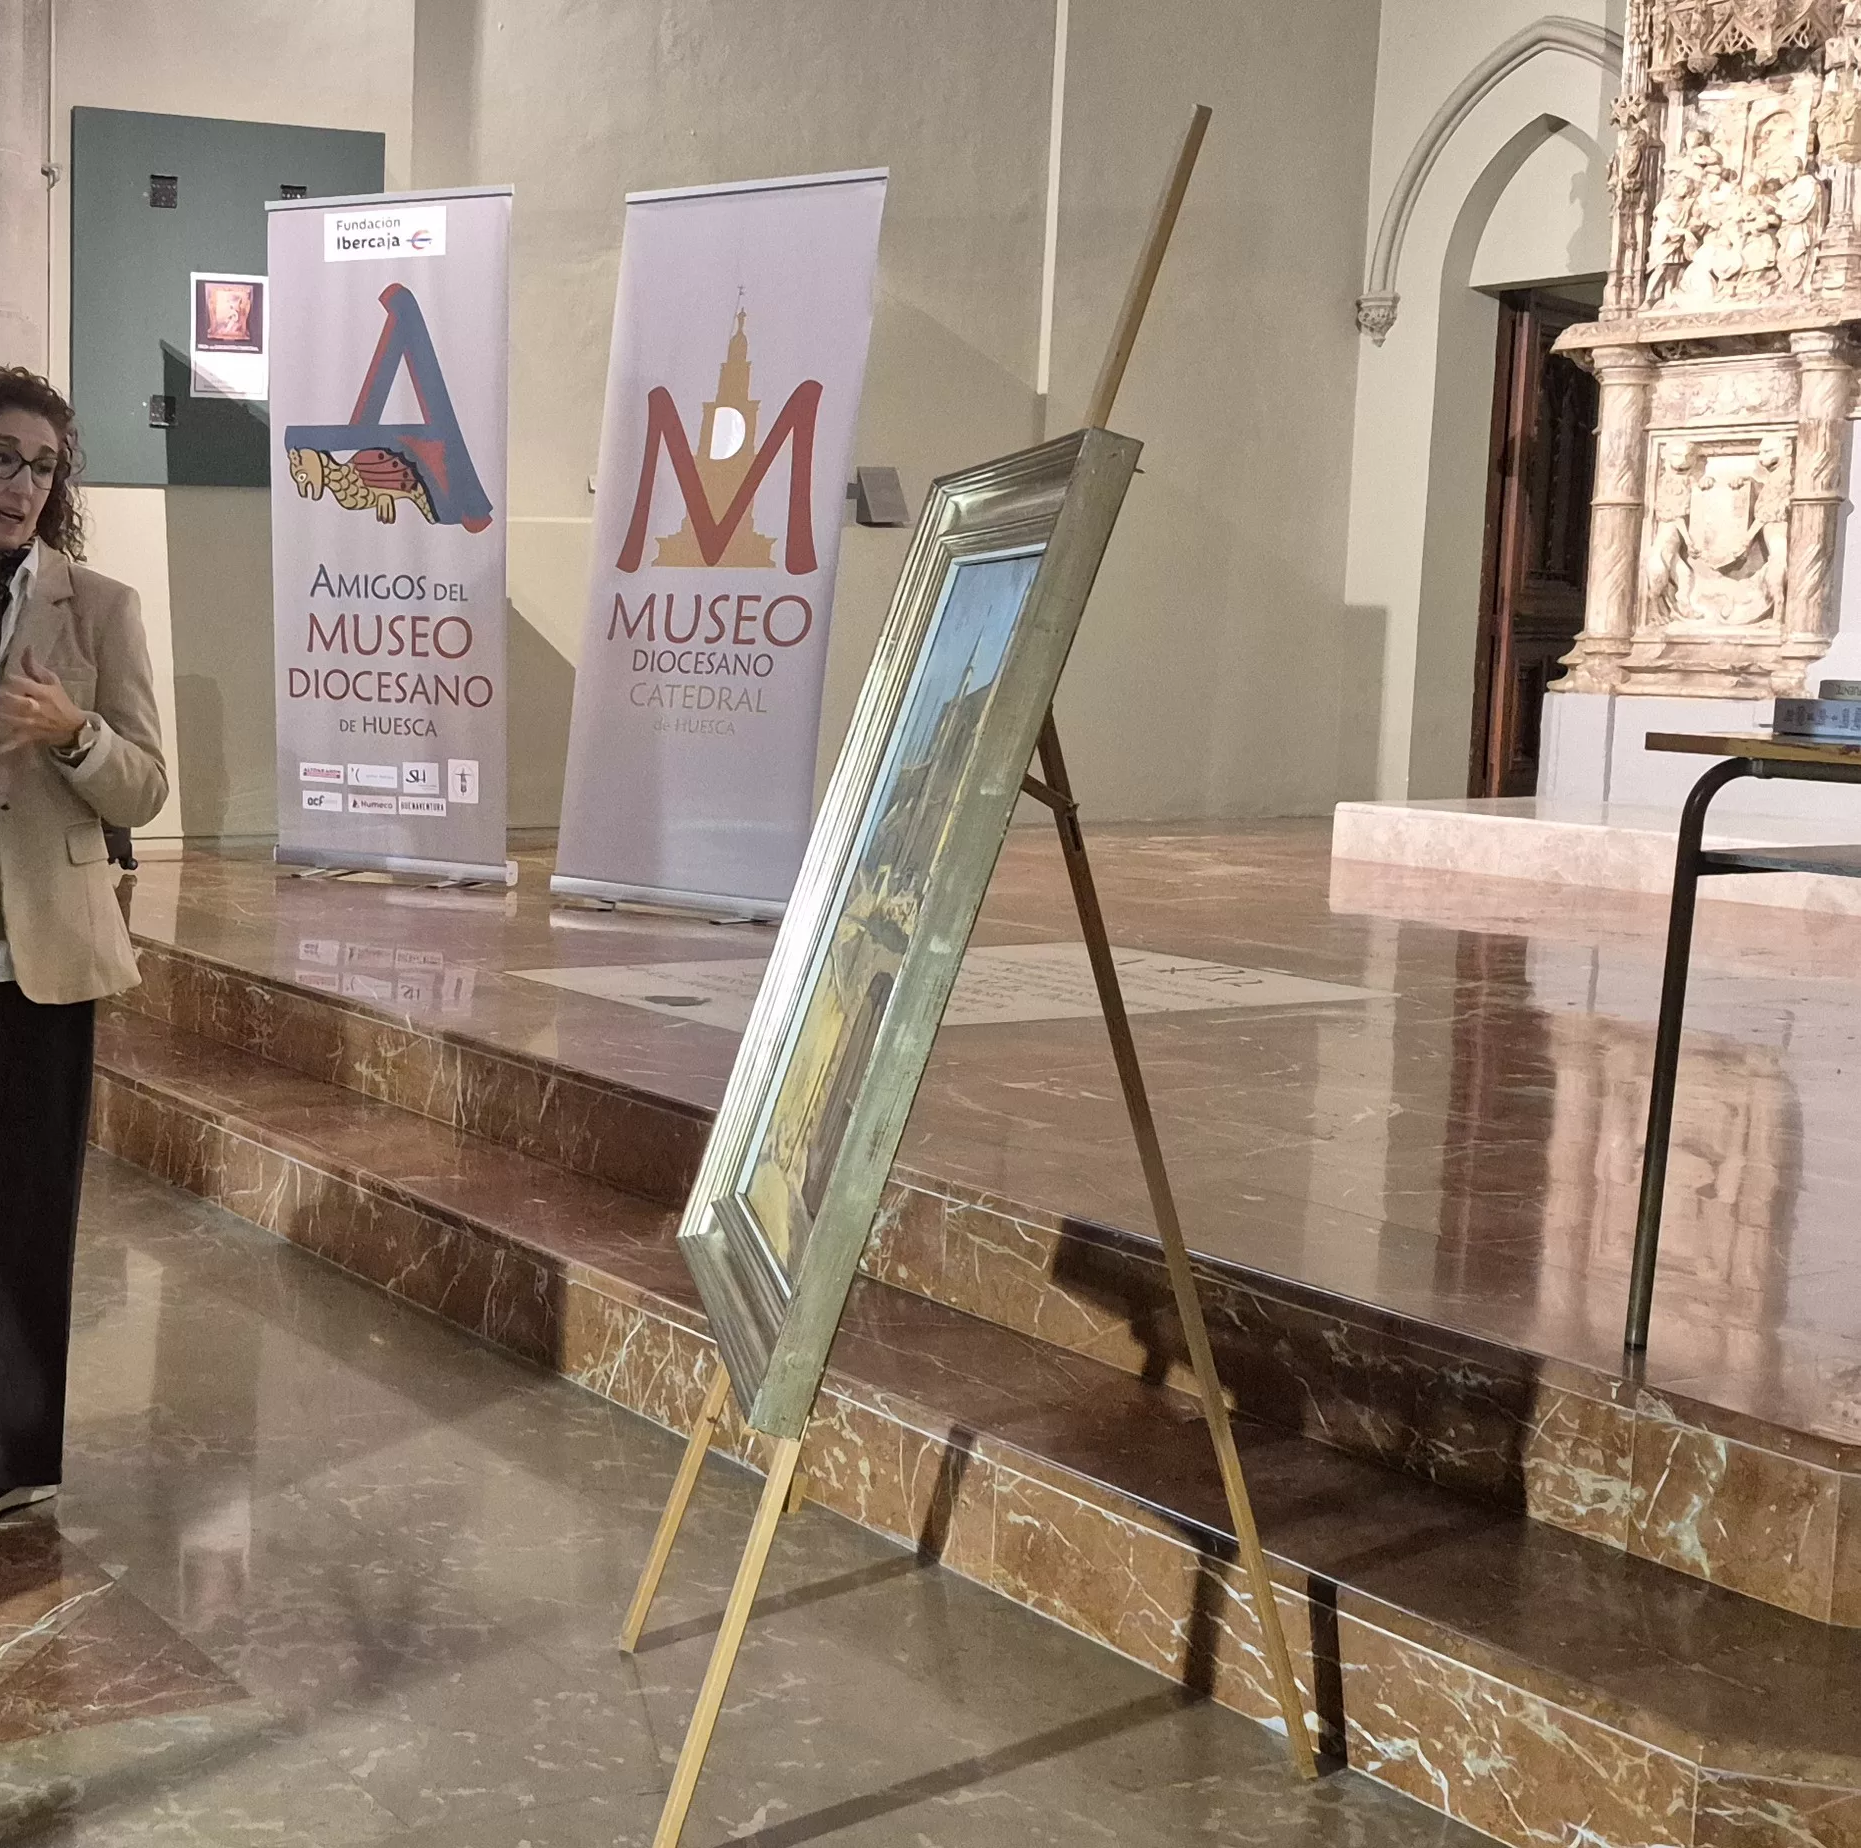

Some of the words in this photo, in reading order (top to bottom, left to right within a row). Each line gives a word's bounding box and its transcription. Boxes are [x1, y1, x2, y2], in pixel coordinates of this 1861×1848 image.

[336, 217, 401, 231] Fundación
[336, 232, 401, 250] Ibercaja
[433, 583, 469, 602] DEL
[607, 592, 813, 647] MUSEO
[307, 612, 473, 659] MUSEO
[632, 649, 774, 678] DIOCESANO
[288, 667, 493, 708] DIOCESANO
[629, 682, 768, 713] CATEDRAL
[339, 719, 357, 733] DE
[362, 716, 438, 737] HUESCA
[653, 716, 671, 732] de
[675, 718, 736, 736] HUESCA
